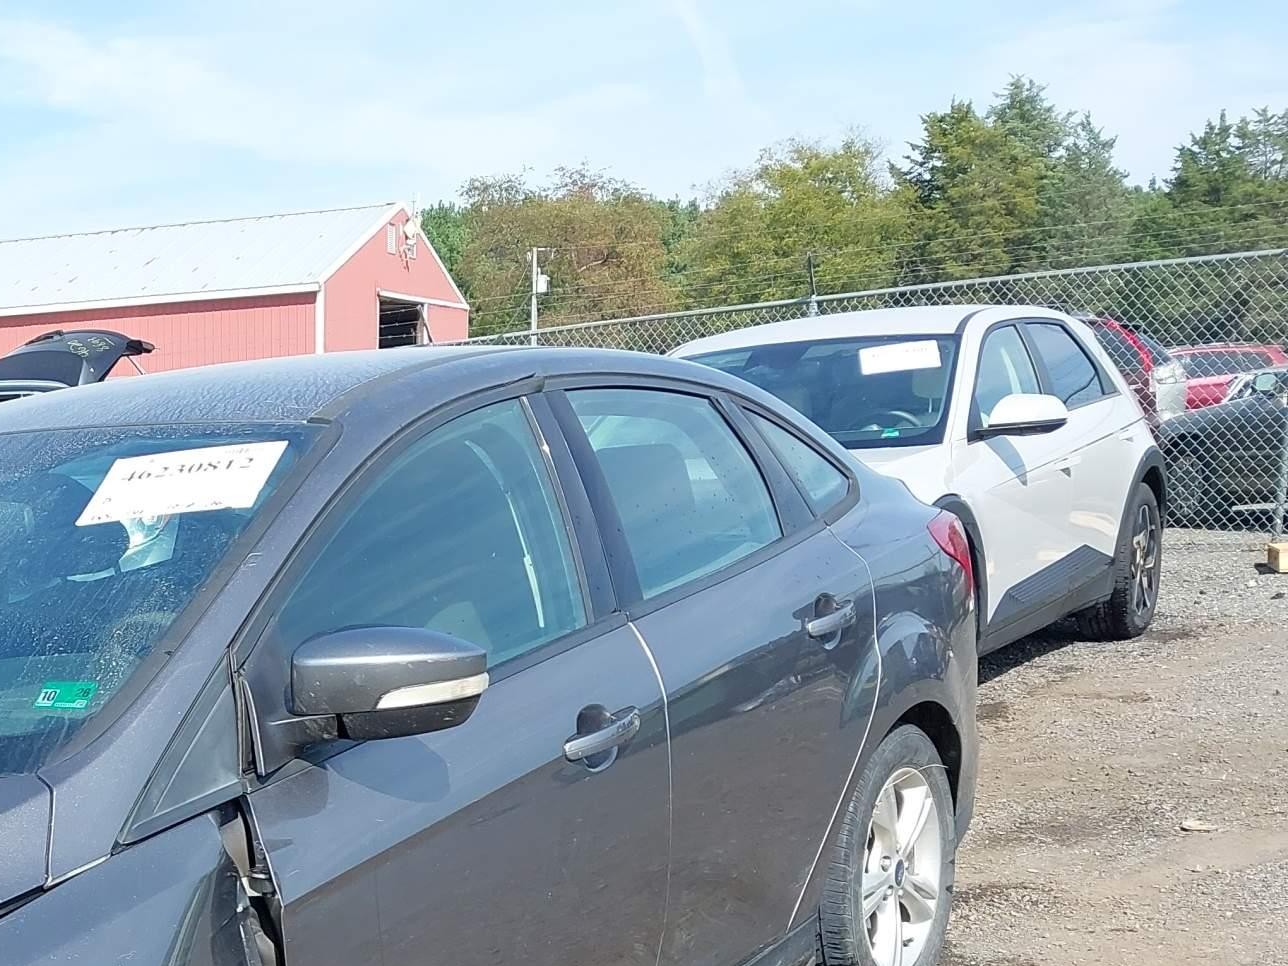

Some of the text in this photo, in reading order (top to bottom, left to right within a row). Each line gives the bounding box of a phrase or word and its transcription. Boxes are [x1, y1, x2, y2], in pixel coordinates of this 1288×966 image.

[121, 457, 254, 482] 46230812
[41, 687, 91, 701] 10 26
